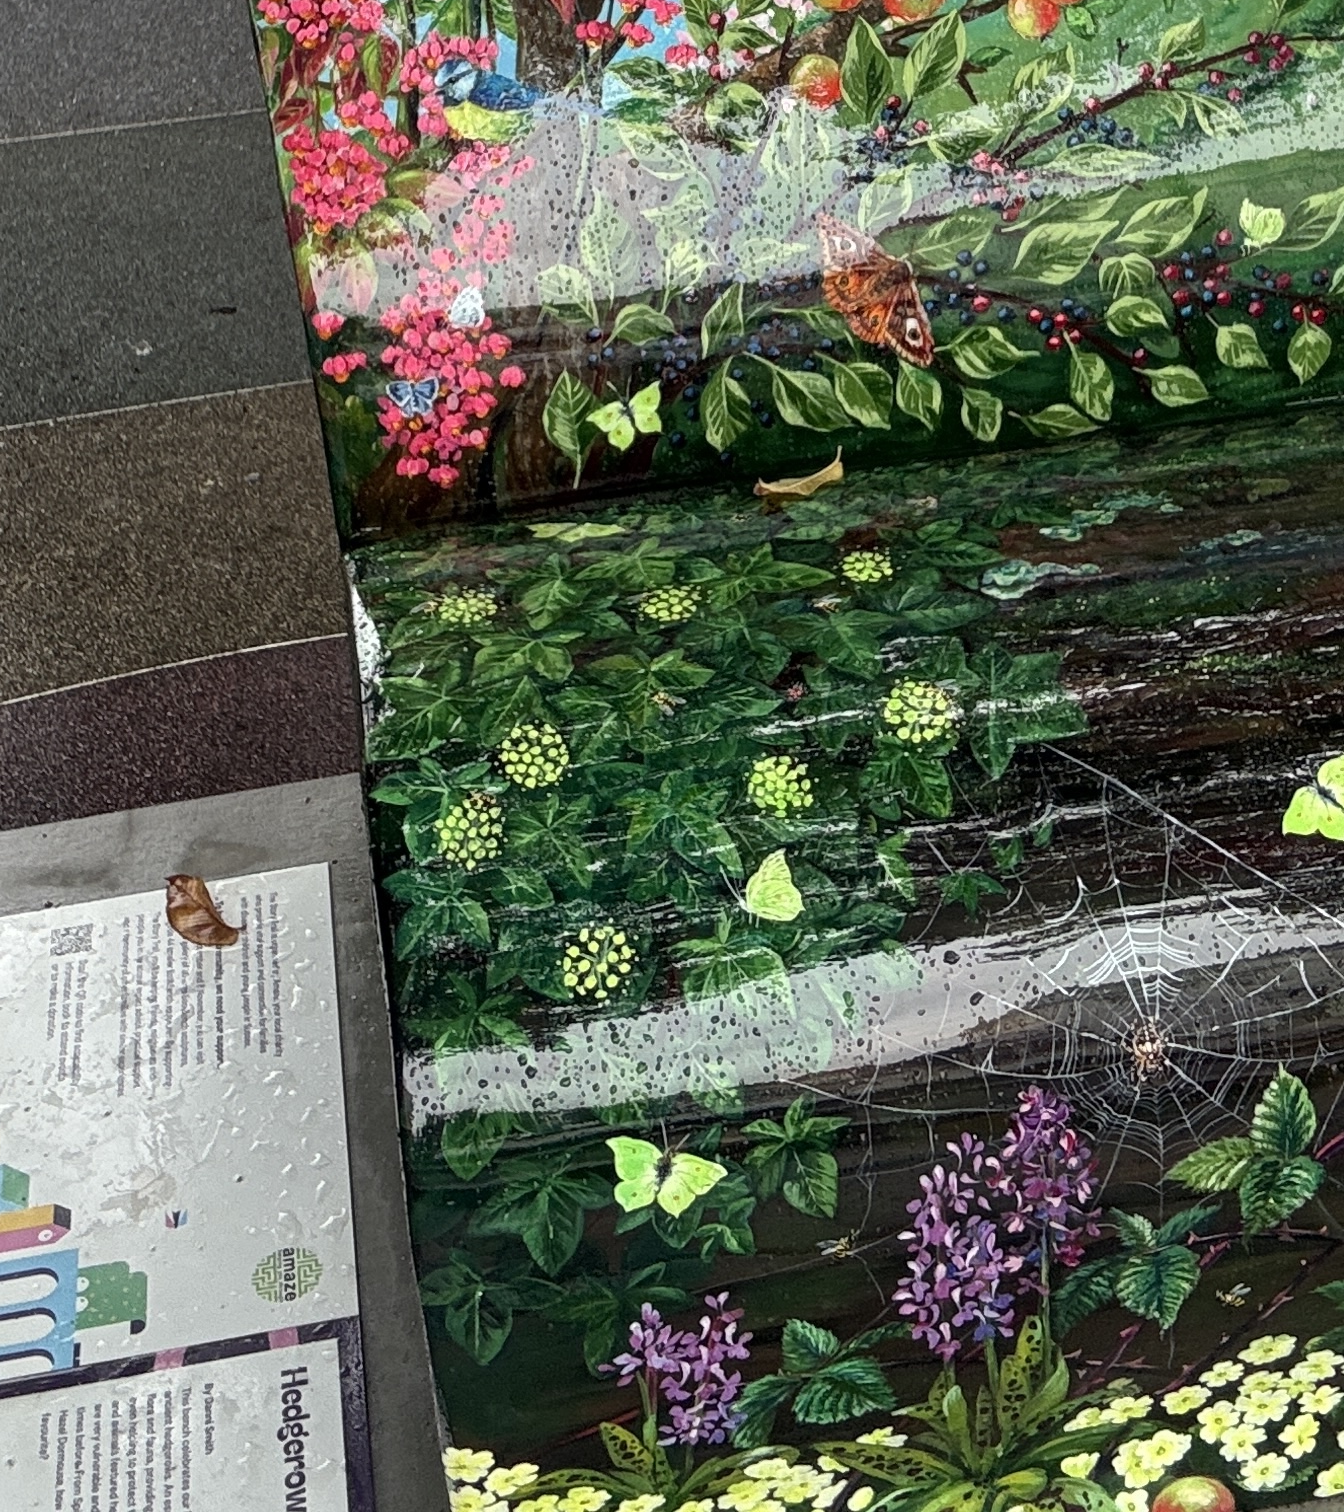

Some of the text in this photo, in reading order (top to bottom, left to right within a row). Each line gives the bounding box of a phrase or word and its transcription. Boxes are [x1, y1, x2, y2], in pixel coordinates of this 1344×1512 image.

[282, 1247, 297, 1302] amaze
[202, 1383, 214, 1395] By
[91, 1421, 101, 1441] very
[182, 1387, 192, 1509] This bench celebrates our
[205, 1426, 214, 1455] Smith
[55, 1437, 67, 1488] Dormouse,
[110, 1458, 120, 1499] featured
[126, 1471, 138, 1507] protect
[143, 1467, 156, 1512] providing
[164, 1484, 174, 1497] An
